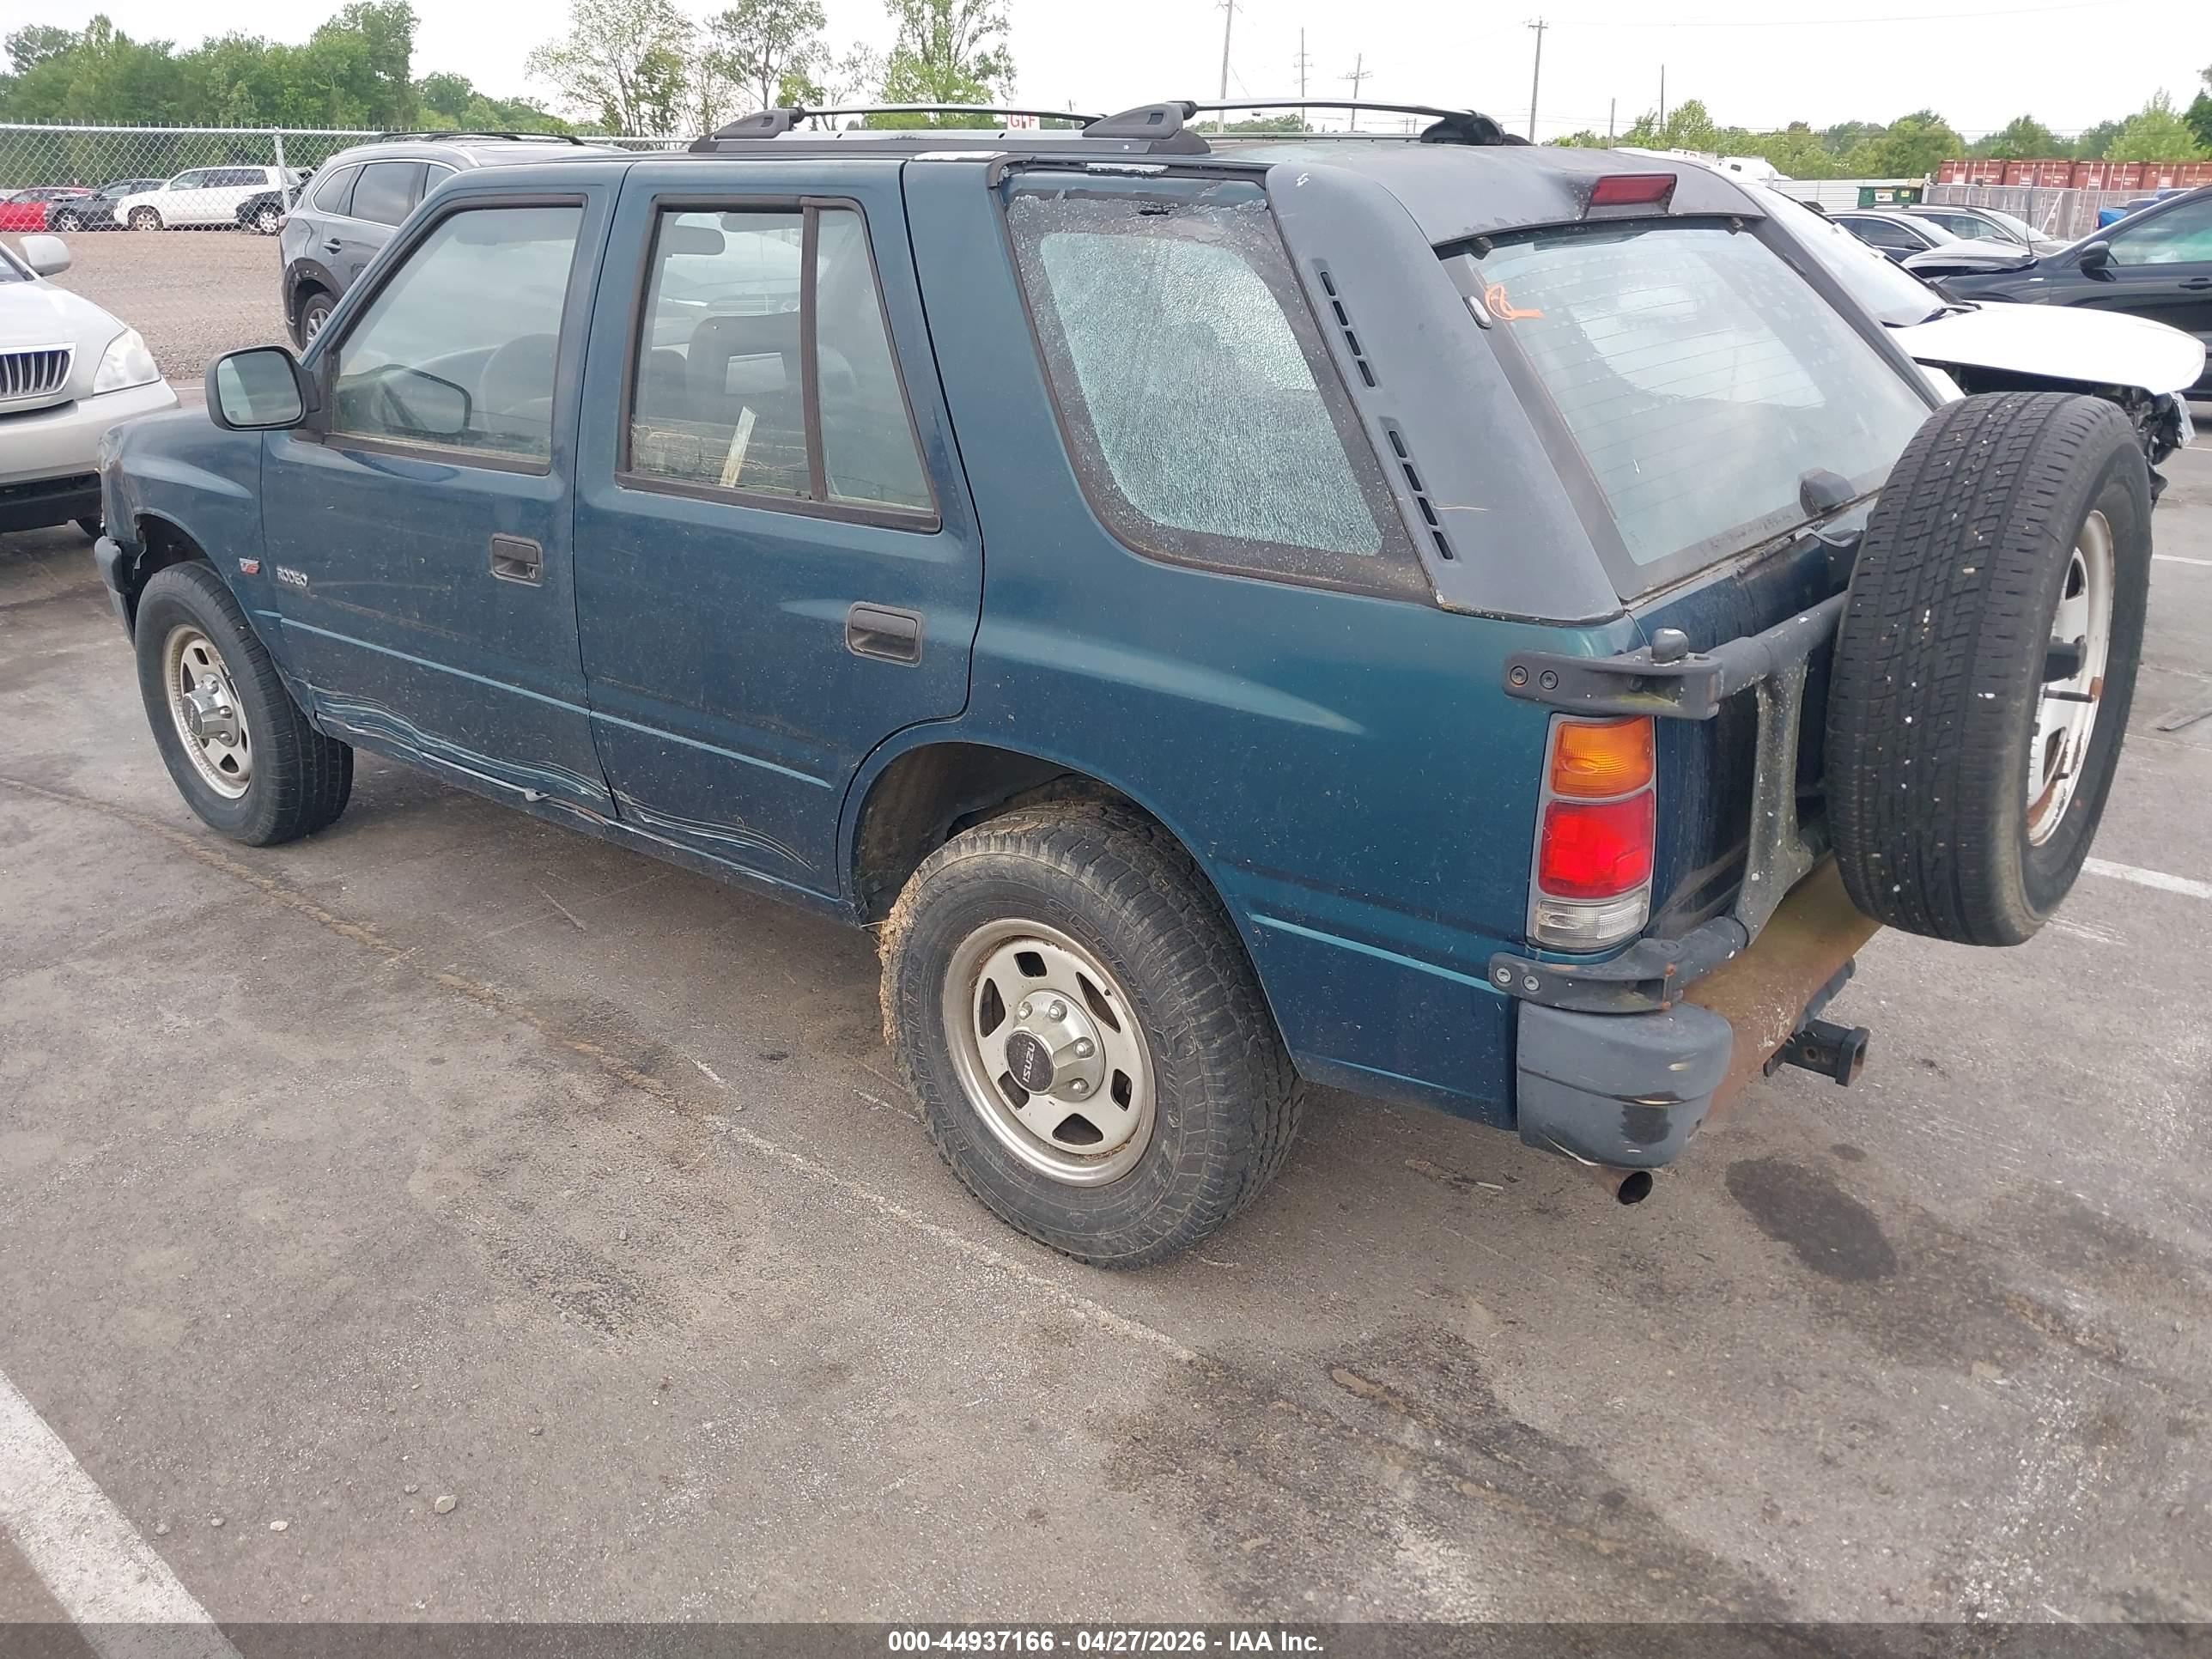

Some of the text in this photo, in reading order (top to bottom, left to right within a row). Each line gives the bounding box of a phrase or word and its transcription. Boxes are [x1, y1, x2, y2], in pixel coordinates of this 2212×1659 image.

[239, 557, 259, 574] V6
[276, 565, 308, 587] RODEO
[1022, 1042, 1036, 1083] ISUZU
